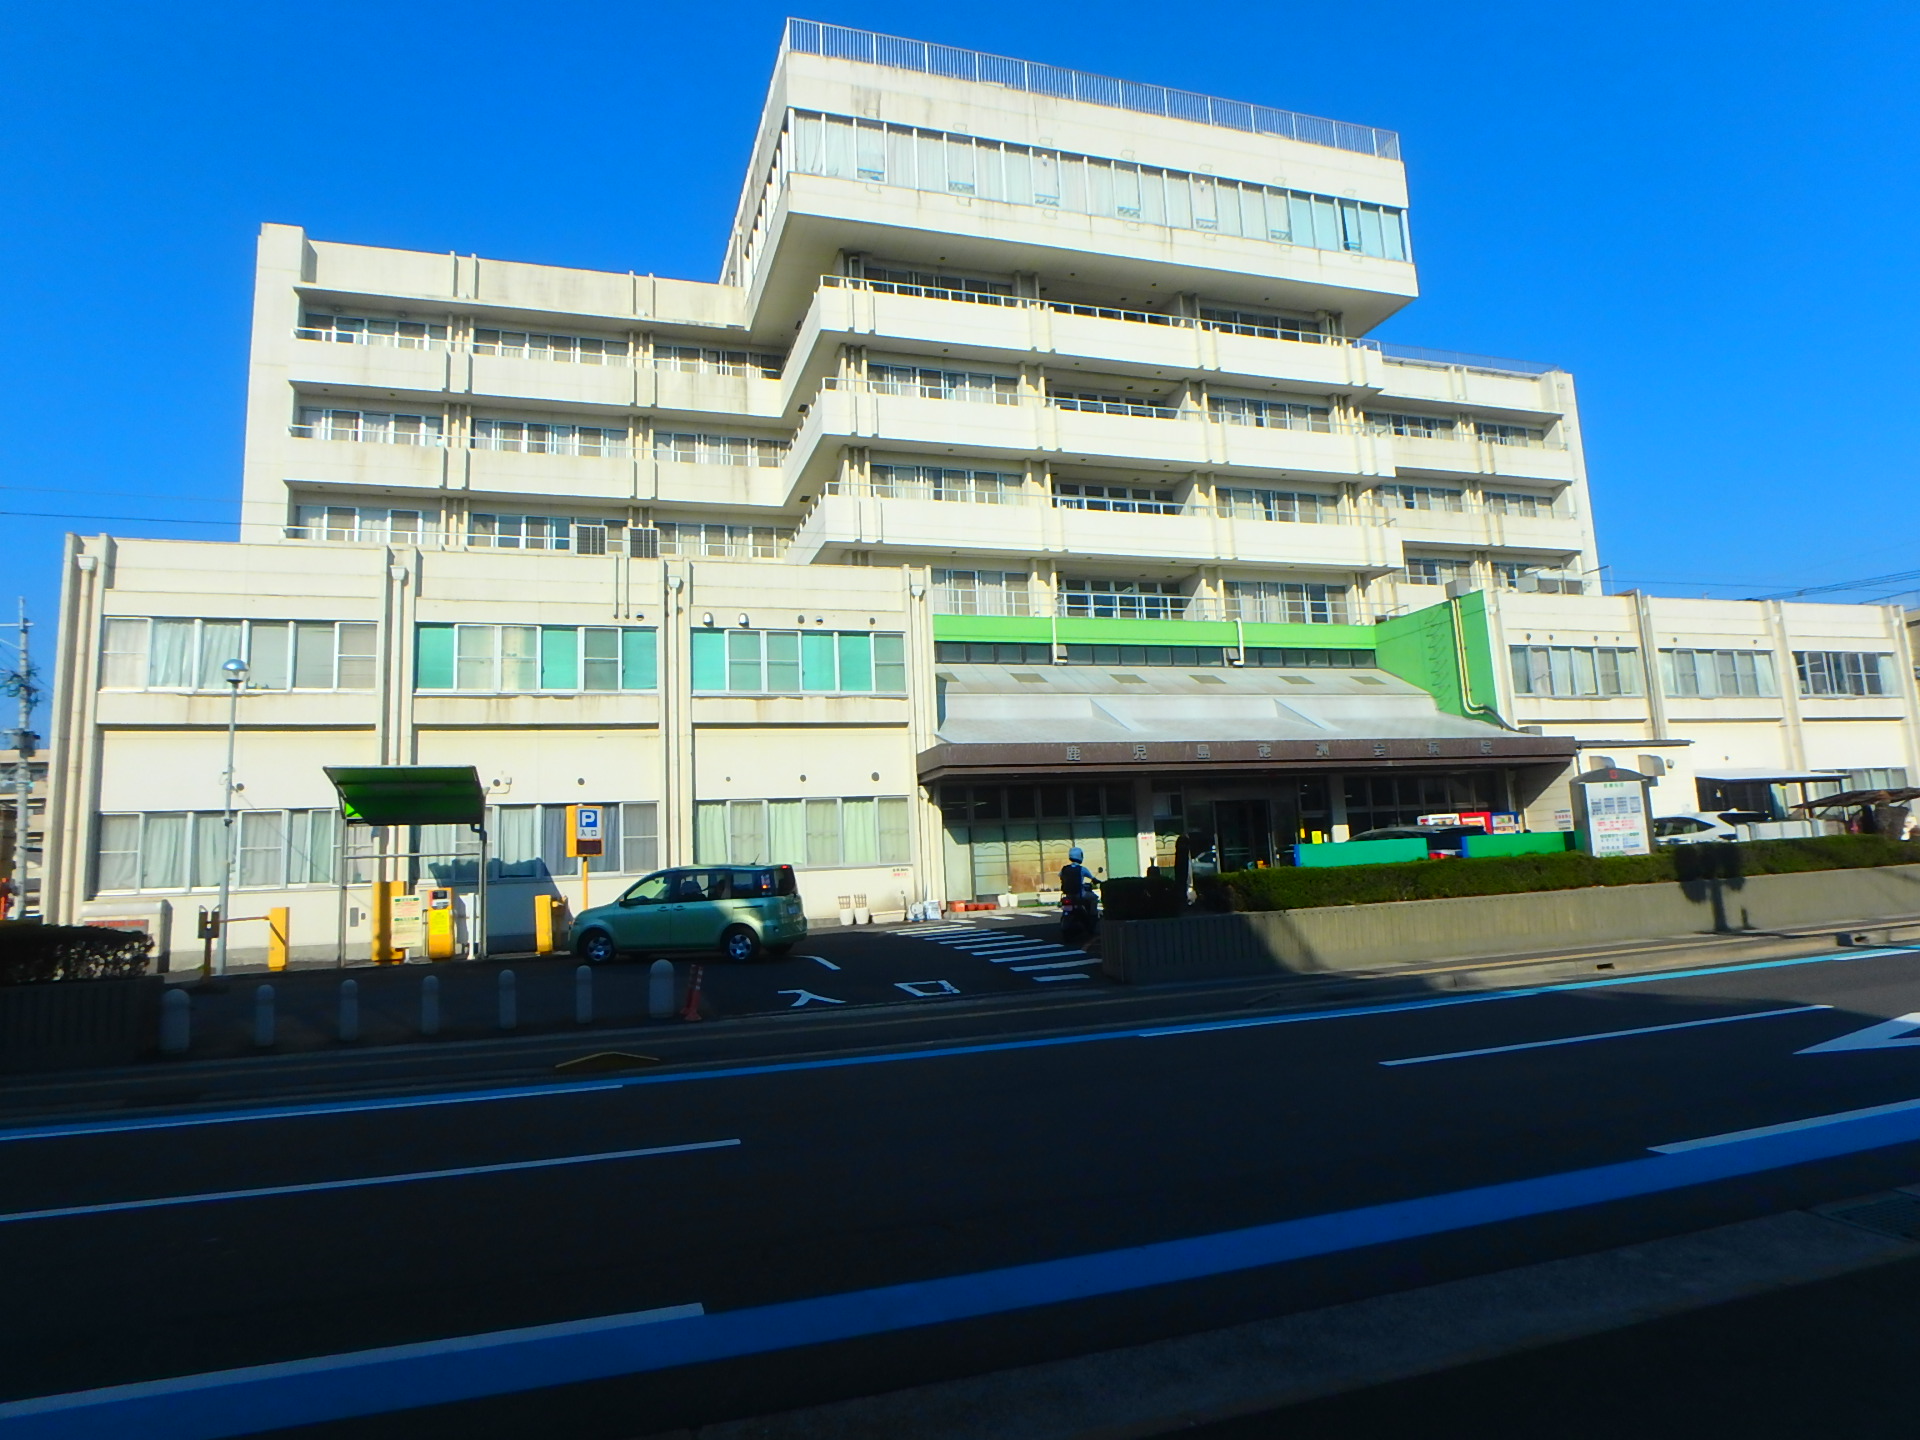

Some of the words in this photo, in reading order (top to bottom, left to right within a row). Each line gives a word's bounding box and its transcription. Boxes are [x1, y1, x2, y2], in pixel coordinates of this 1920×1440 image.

[581, 811, 596, 827] P
[581, 829, 597, 837] 入口
[777, 979, 961, 1007] 入口
